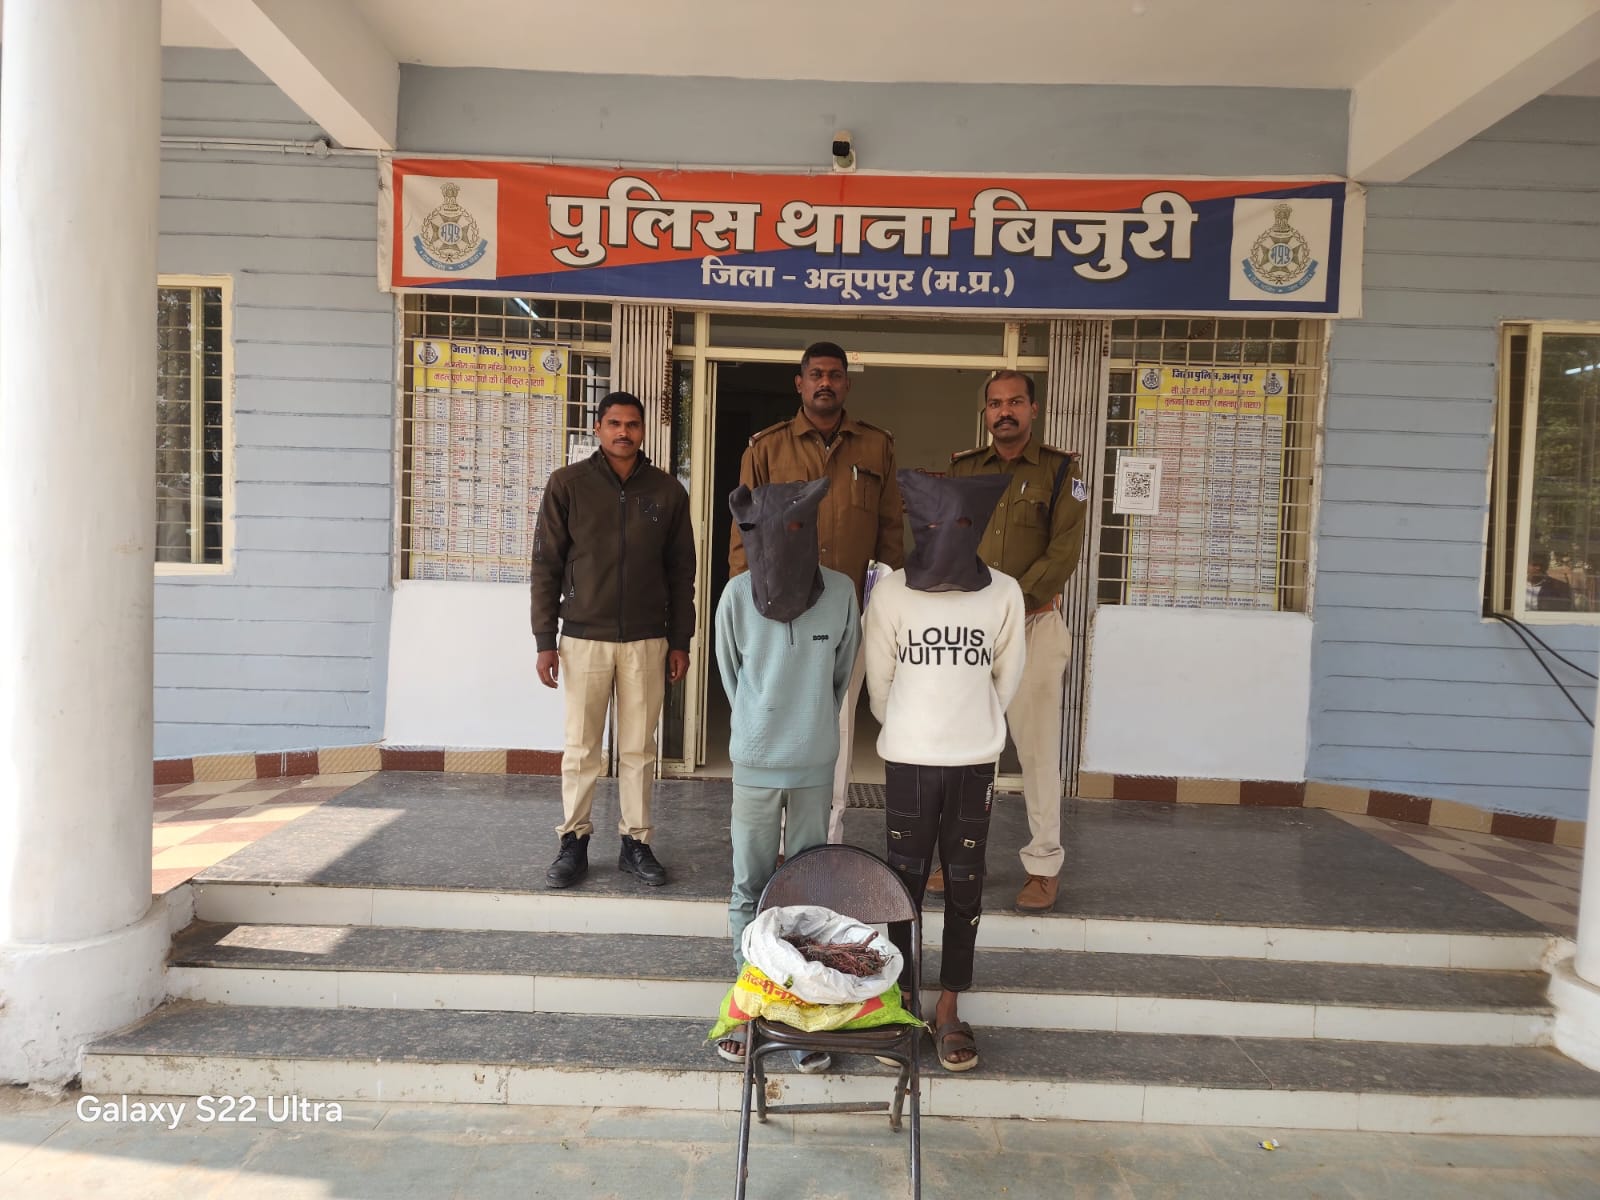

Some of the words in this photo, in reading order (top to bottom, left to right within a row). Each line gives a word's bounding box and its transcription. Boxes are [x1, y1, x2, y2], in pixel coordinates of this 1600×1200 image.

[546, 176, 761, 268] पुलिस
[776, 200, 956, 257] थाना
[969, 187, 1199, 281] बिजुरी
[701, 255, 775, 288] जिला
[804, 268, 915, 300] अनूपपुर
[921, 266, 1015, 298] (म.प्र.)
[908, 626, 985, 648] LOUIS
[898, 646, 992, 666] VUITTON
